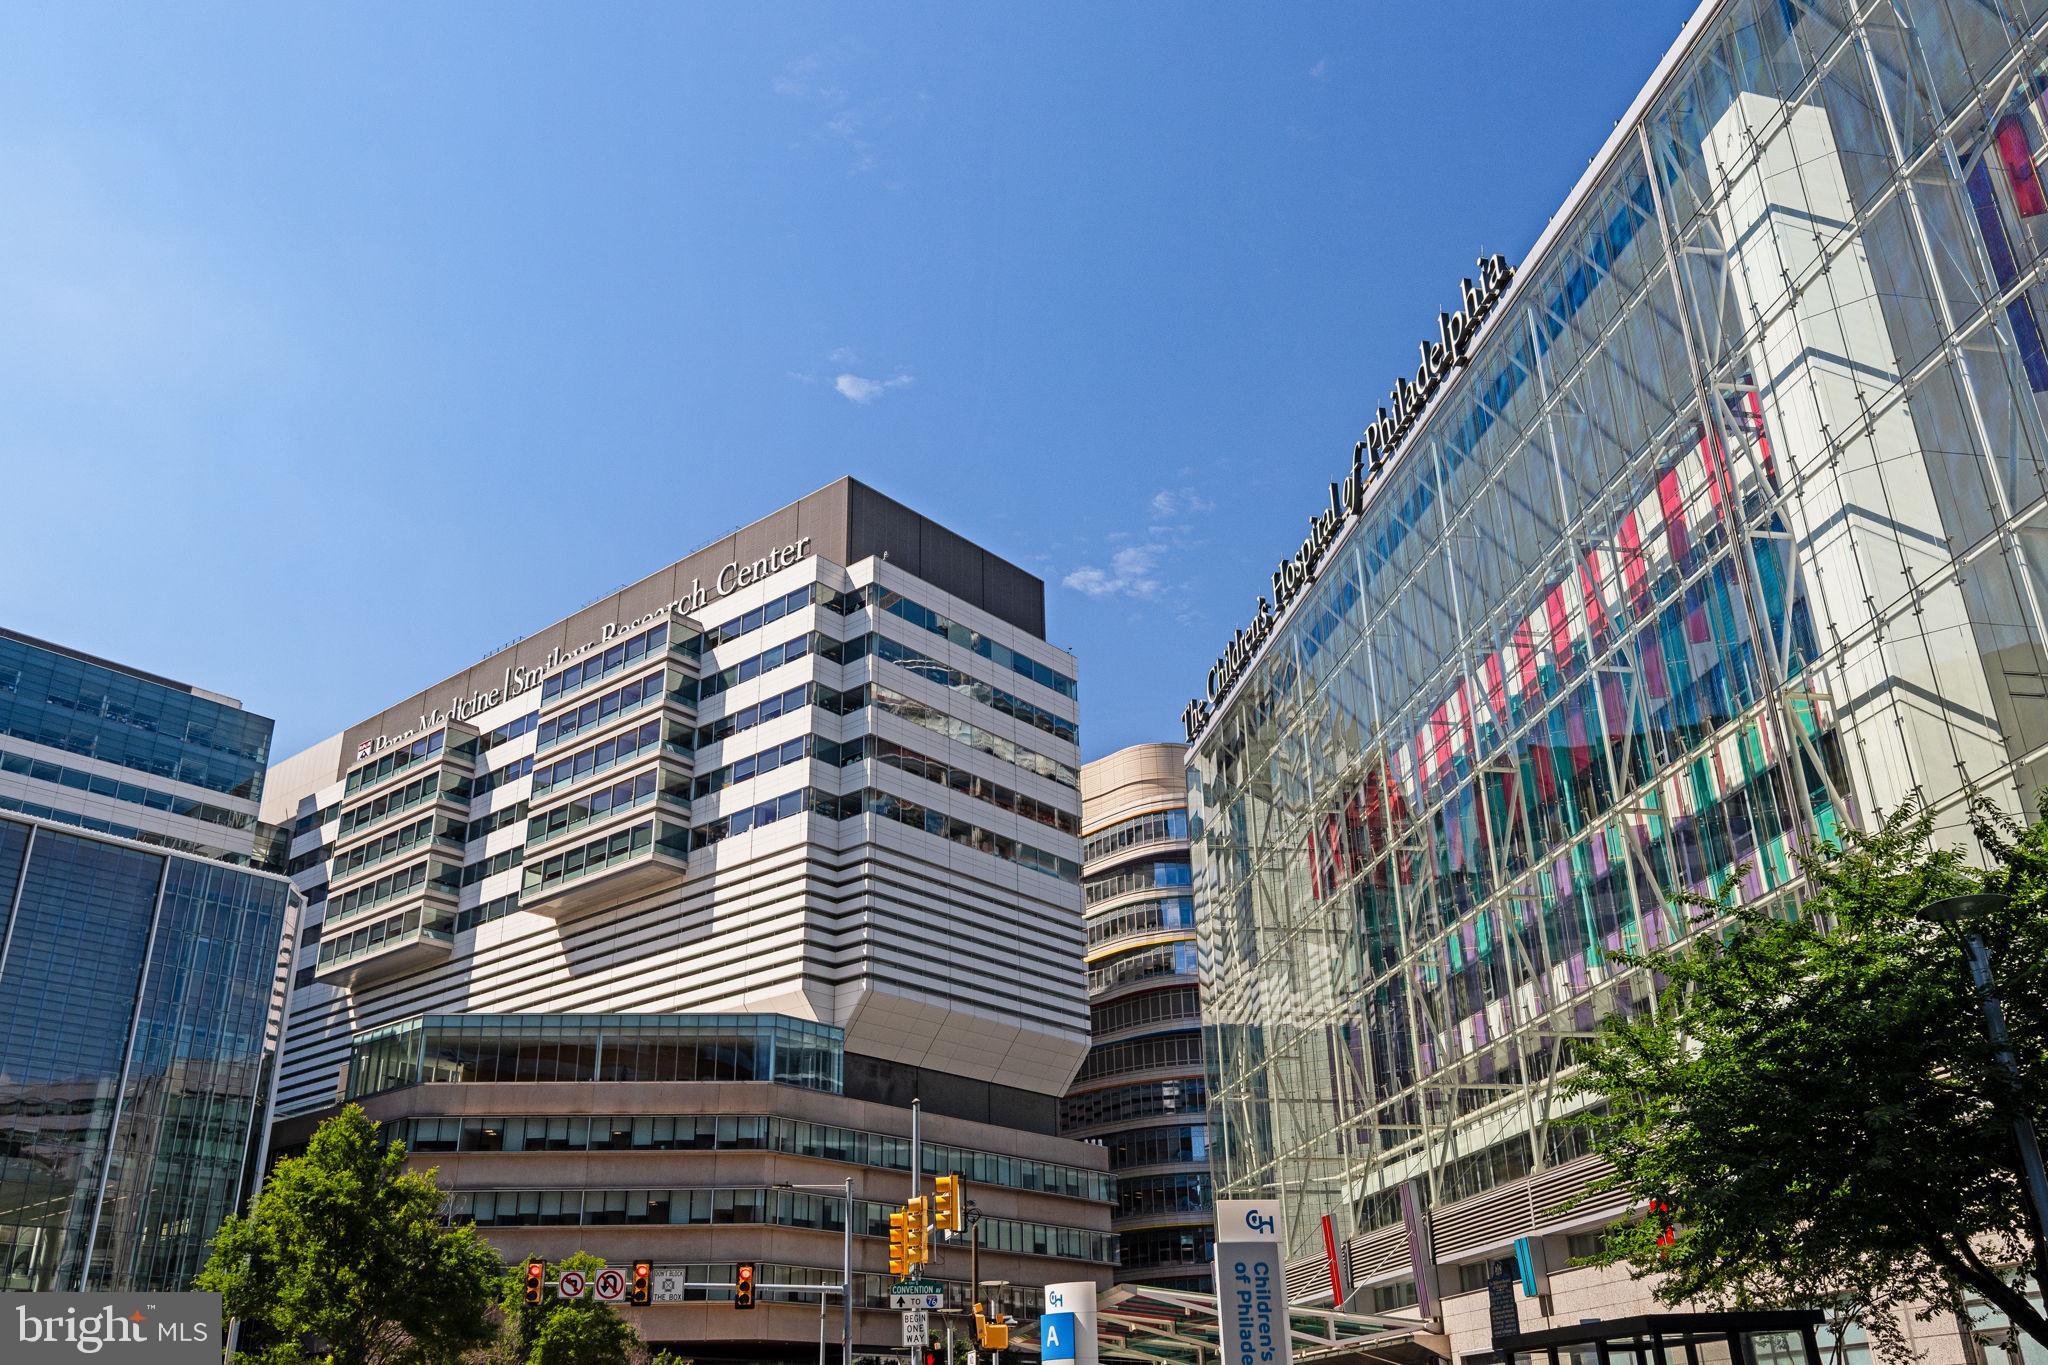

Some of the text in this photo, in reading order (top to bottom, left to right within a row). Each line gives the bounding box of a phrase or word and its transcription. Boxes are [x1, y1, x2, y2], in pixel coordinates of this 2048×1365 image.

[1181, 254, 1509, 743] The Children's Hospital of Philadelphia
[717, 537, 810, 596] Center
[669, 1293, 682, 1301] BOX
[892, 1285, 934, 1294] CONVENTION
[904, 1314, 926, 1323] BEGIN
[1235, 1262, 1255, 1365] of Philade
[1254, 1262, 1275, 1362] Children's
[907, 1325, 924, 1333] ONE
[1047, 1325, 1060, 1347] A
[906, 1334, 925, 1342] WAY
